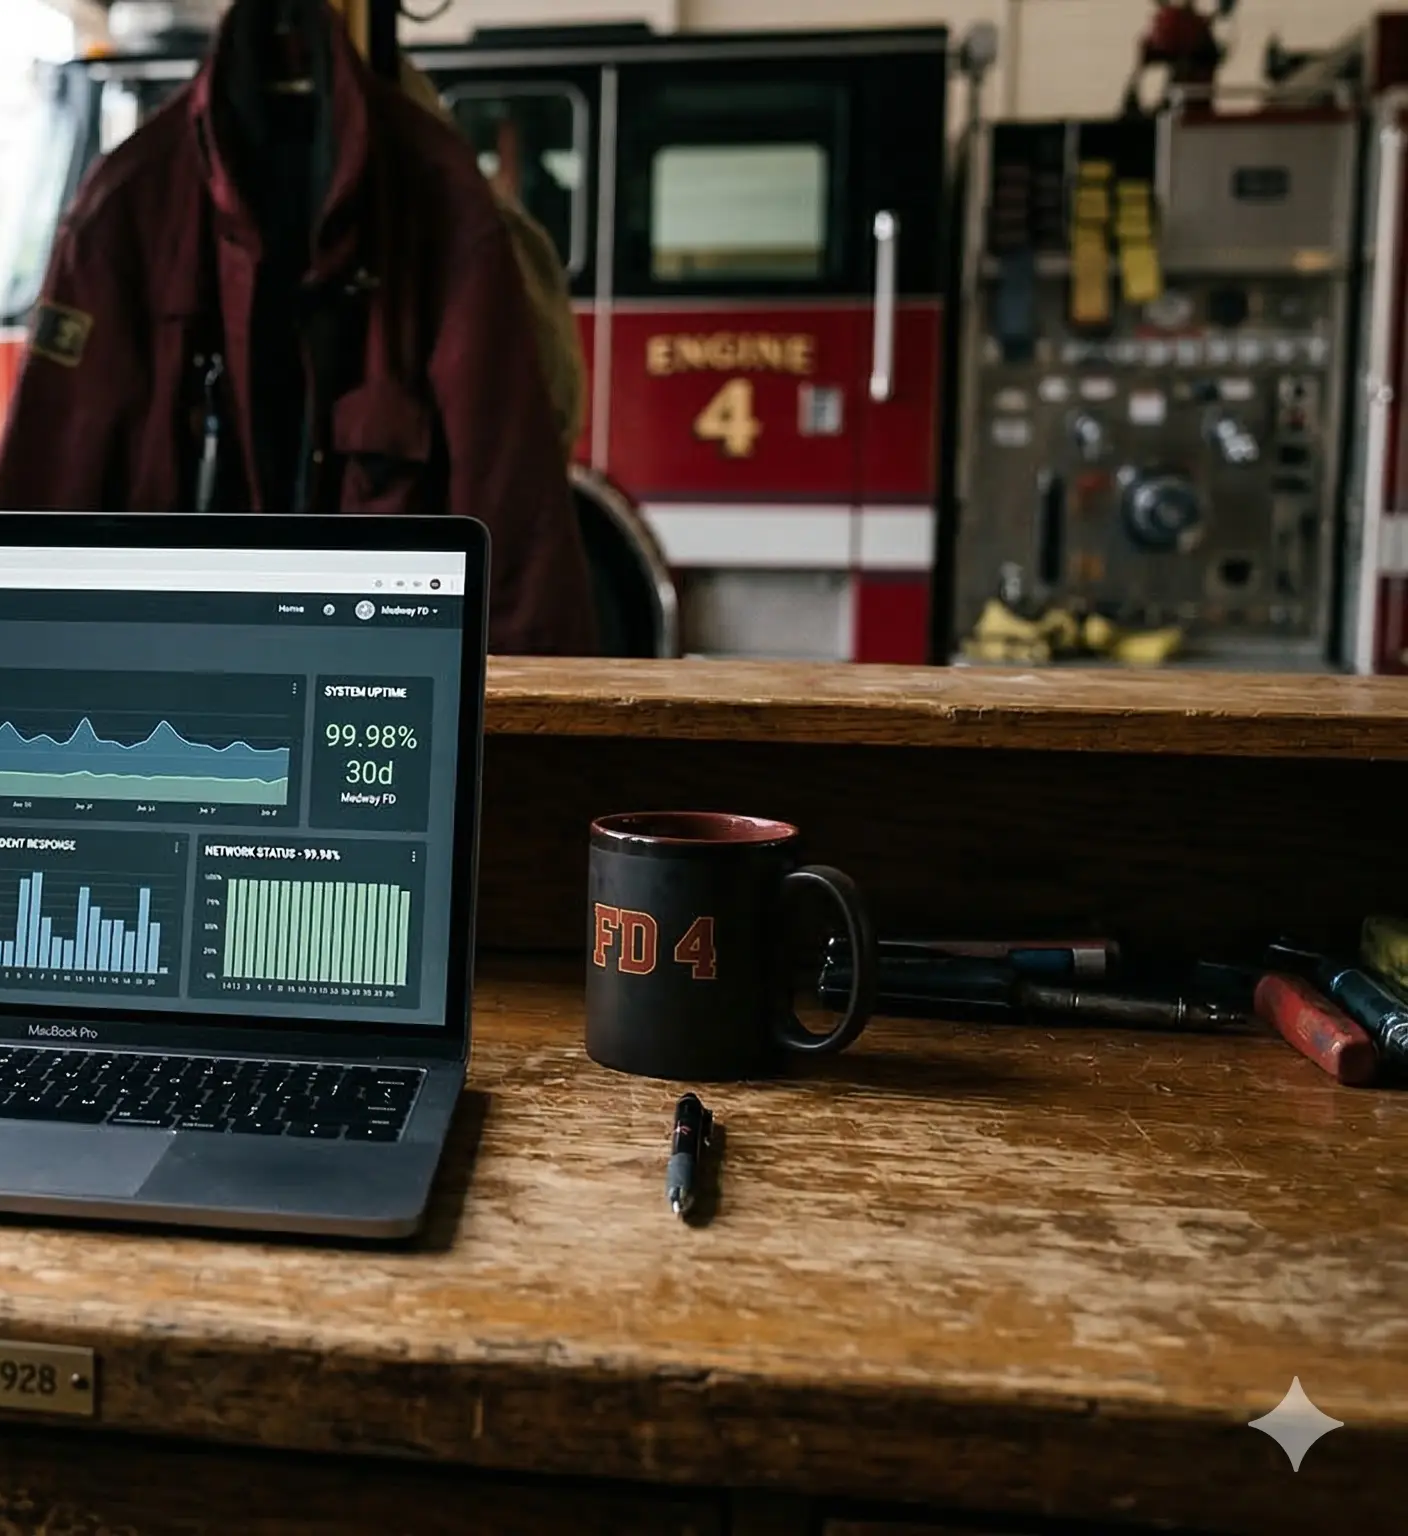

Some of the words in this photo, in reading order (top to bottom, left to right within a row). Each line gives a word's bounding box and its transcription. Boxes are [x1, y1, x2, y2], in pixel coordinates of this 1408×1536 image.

[647, 332, 814, 375] ENGINE
[694, 377, 761, 457] 4
[324, 685, 366, 697] SYSTEM
[367, 686, 408, 698] UPTIME
[326, 724, 418, 749] 99.98%
[346, 760, 393, 785] 30d
[340, 792, 380, 807] Medway
[382, 793, 397, 804] FD
[204, 844, 255, 858] NETWORK
[255, 846, 296, 859] STATUS
[593, 902, 658, 975] FD
[674, 916, 718, 980] 4
[28, 1024, 78, 1038] MacBook
[80, 1026, 98, 1039] Pro
